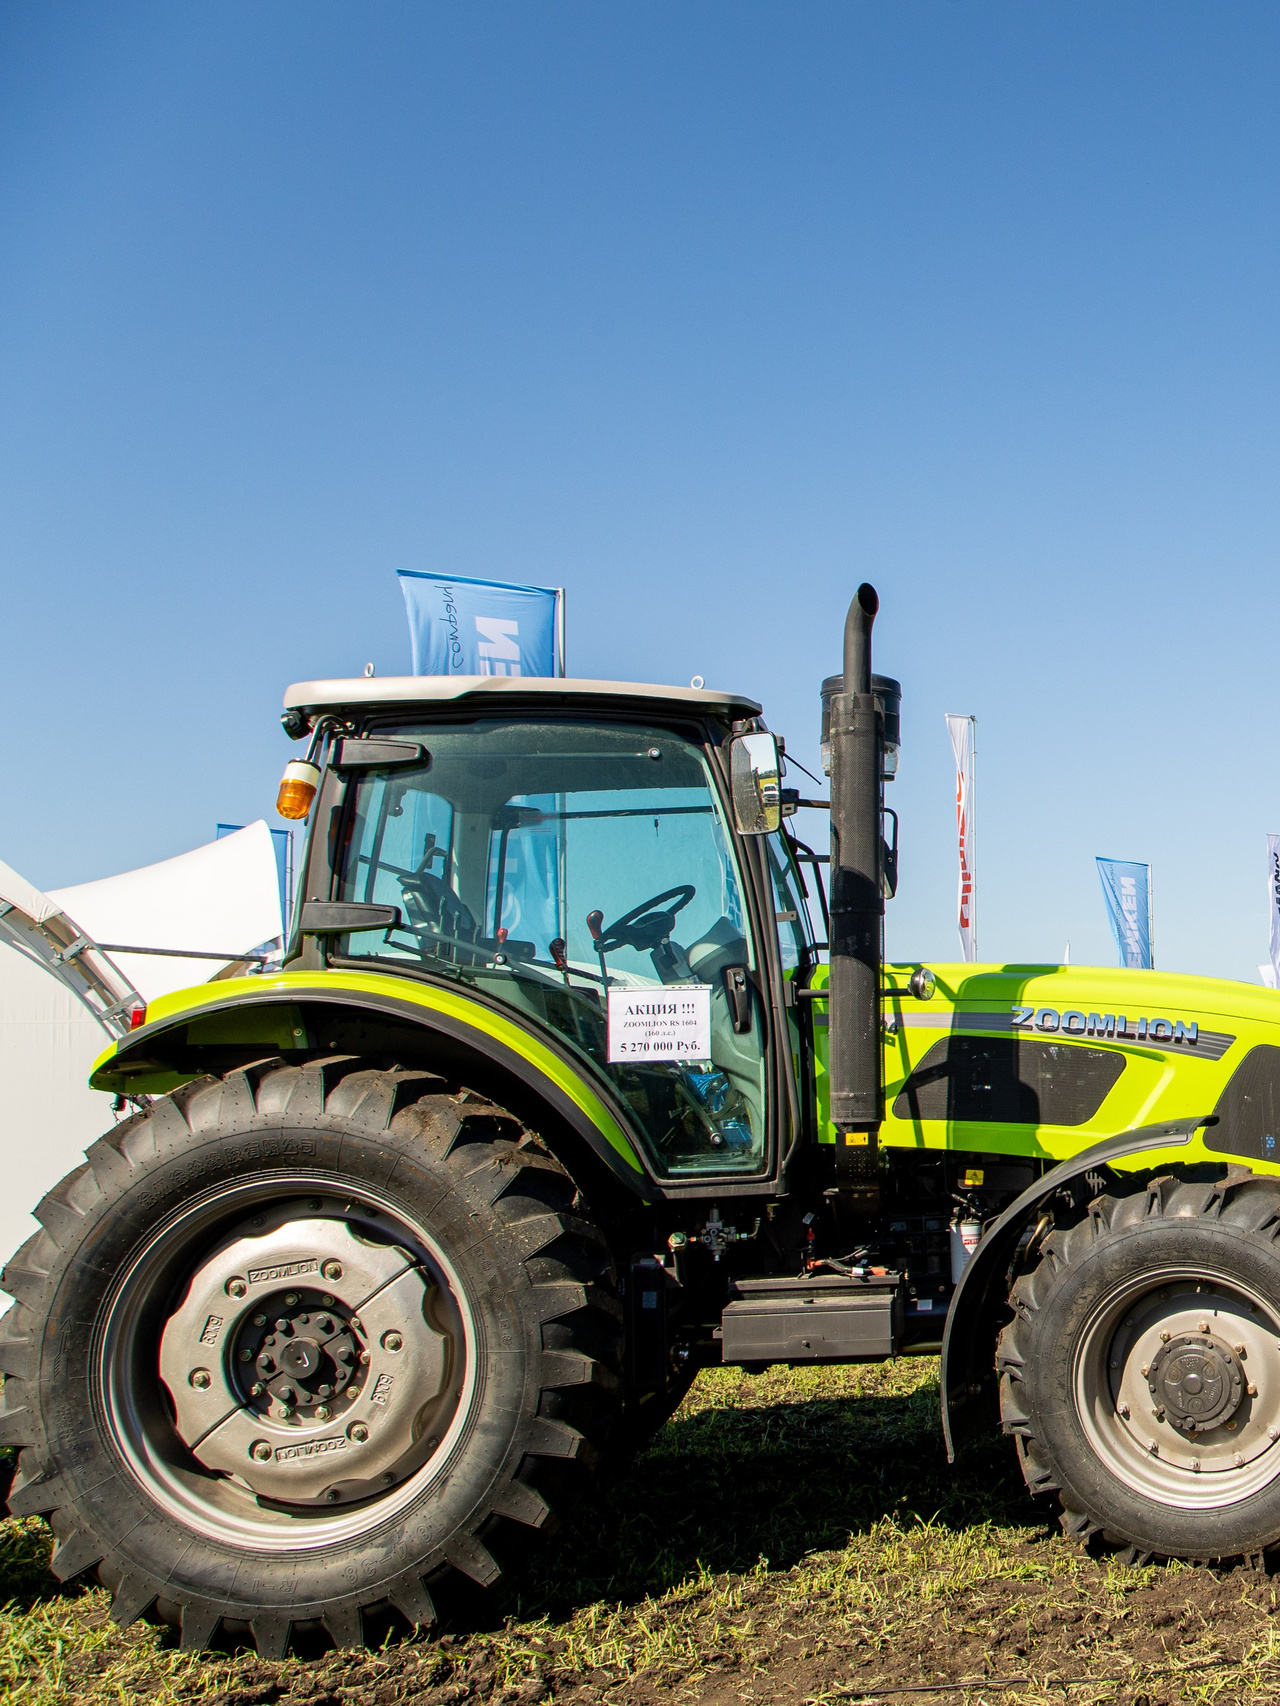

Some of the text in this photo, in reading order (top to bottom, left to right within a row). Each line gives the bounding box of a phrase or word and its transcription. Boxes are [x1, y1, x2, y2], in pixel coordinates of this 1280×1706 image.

[625, 1003, 695, 1016] АКЦИЯ !!!
[623, 1020, 667, 1028] ZOOMLION
[1010, 1005, 1199, 1046] ZOOMLION
[620, 1041, 700, 1053] 5 270 000 Руб.
[250, 1261, 318, 1282] ZOOMLION
[276, 1438, 346, 1461] ZOOMLION
[252, 1578, 299, 1595] R-1
